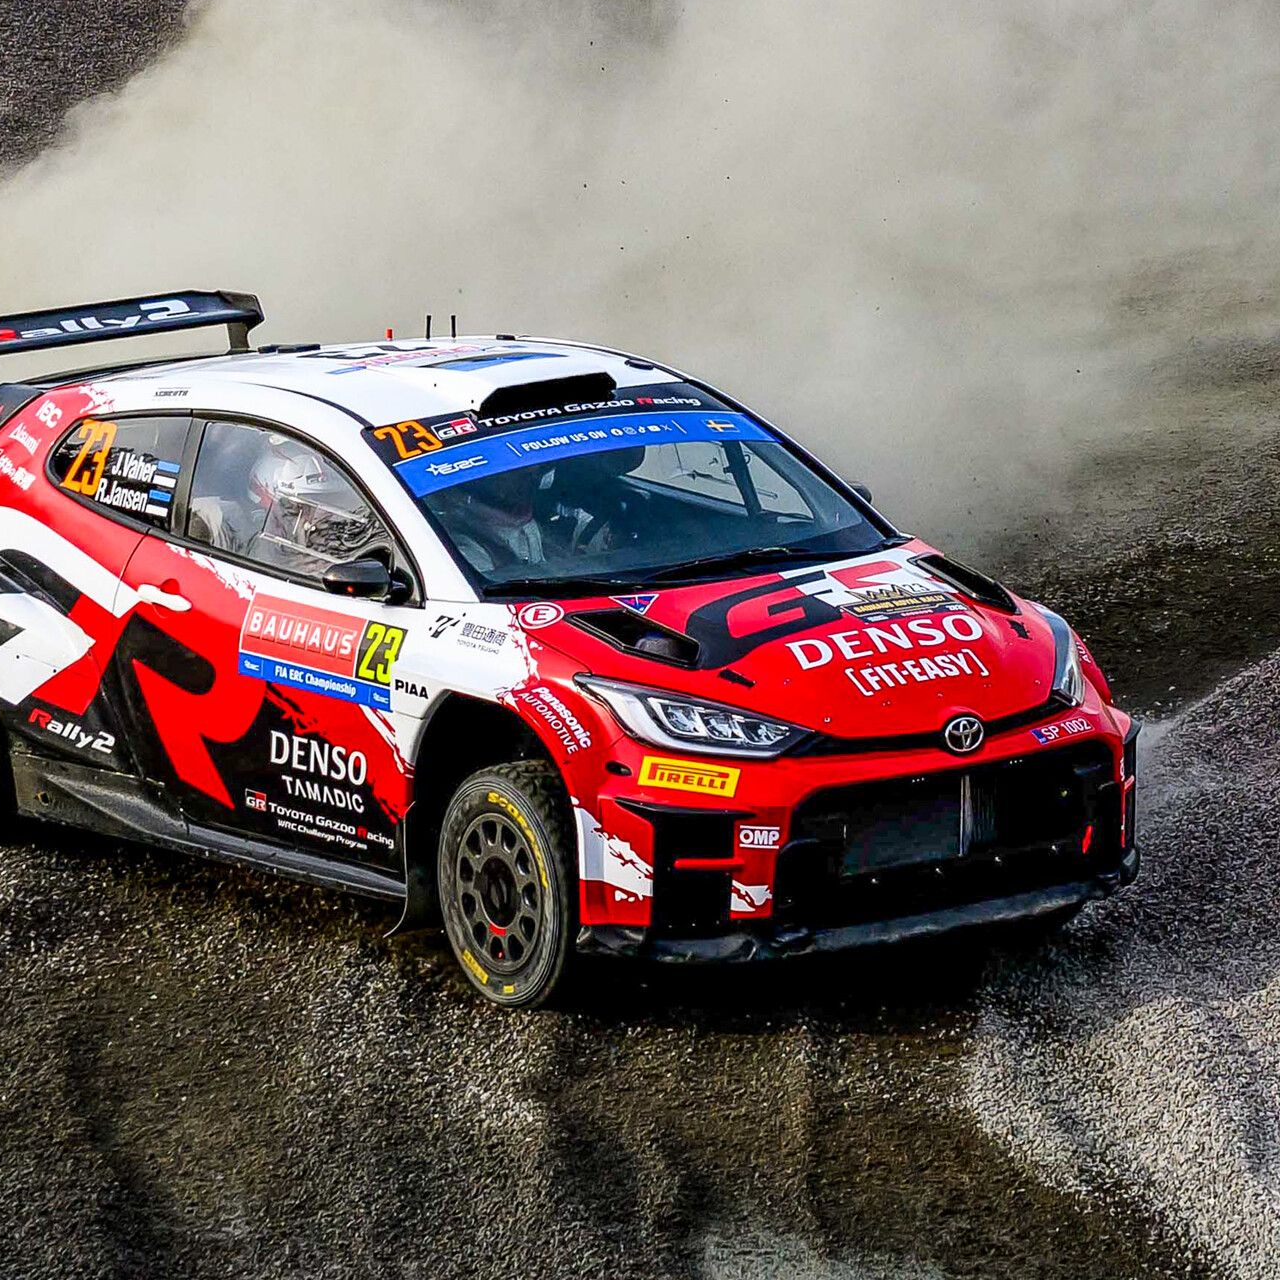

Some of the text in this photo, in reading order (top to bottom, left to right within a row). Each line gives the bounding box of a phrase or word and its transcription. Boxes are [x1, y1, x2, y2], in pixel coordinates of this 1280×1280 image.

[478, 396, 702, 428] TOYOTA GAZOO Racing
[374, 419, 443, 460] 23
[436, 421, 475, 440] GR
[521, 429, 608, 452] FOLLOW US ON
[59, 419, 117, 495] 23
[249, 611, 354, 656] BAUHAUS
[457, 639, 476, 649] TOYOTA
[784, 615, 983, 670] DENSO
[358, 623, 403, 684] 23
[274, 665, 357, 697] FIA ERC Championship
[395, 679, 429, 700] PIAA
[29, 708, 116, 754] Rally2
[518, 692, 579, 755] AUTOMOTIVE
[532, 687, 591, 749] Panasonic
[1041, 718, 1091, 741] SP 1002
[270, 730, 367, 786] DENSO
[648, 762, 730, 790] PIRELLI
[245, 795, 267, 811] GR
[281, 775, 365, 813] TAMADIC
[268, 802, 395, 849] TOYOTA GAZOO Racing
[278, 819, 368, 850] WRC Challenge Program
[739, 829, 780, 845] OMP
